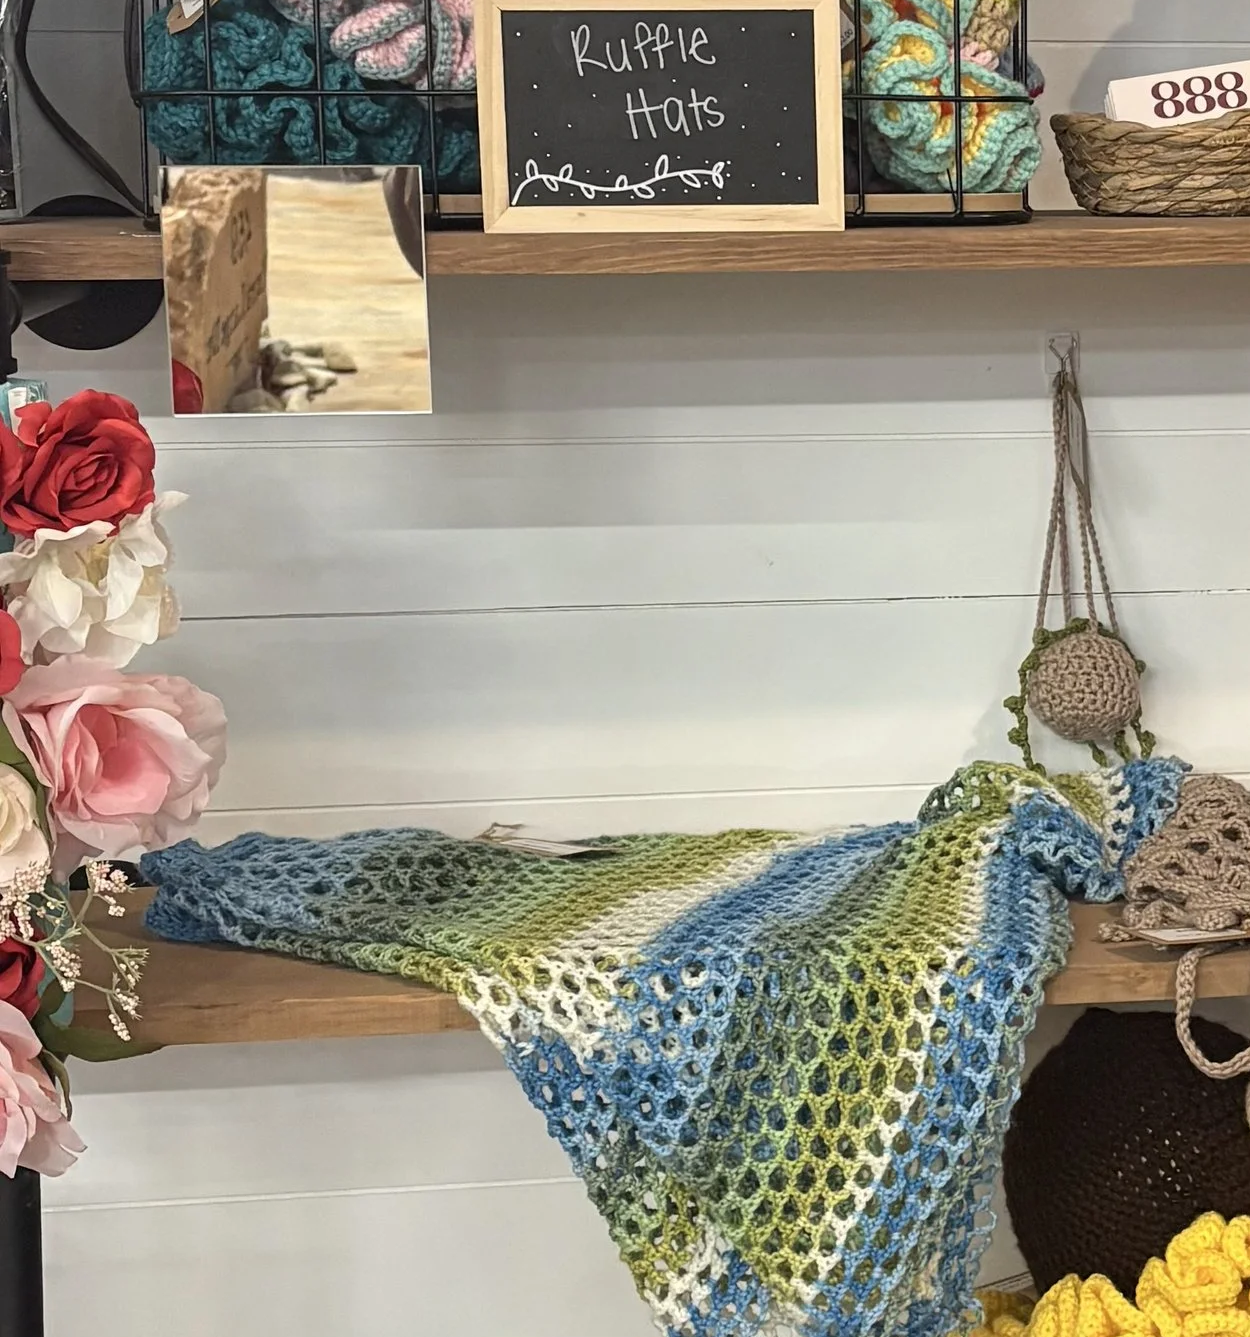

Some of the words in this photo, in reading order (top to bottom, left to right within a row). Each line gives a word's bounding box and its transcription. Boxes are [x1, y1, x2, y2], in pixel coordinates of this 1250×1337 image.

[571, 22, 716, 76] Ruffle
[626, 88, 725, 139] Hats
[1151, 71, 1248, 119] 888
